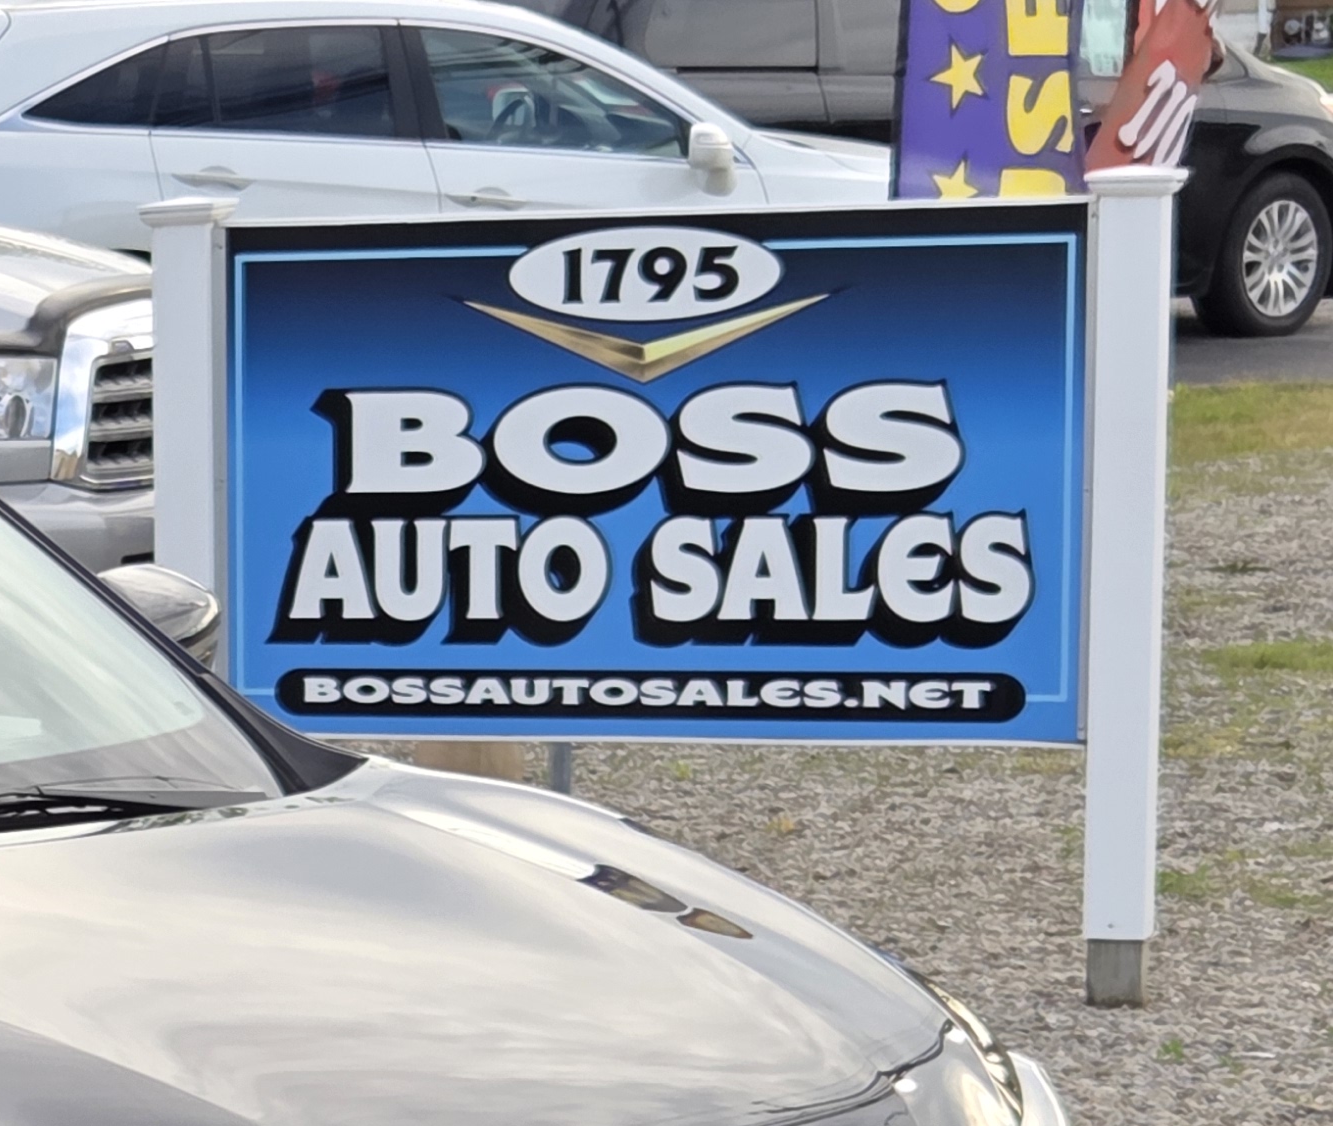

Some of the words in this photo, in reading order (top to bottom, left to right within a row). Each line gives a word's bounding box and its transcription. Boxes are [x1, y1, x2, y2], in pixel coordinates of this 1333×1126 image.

[559, 245, 740, 303] 1795
[335, 383, 963, 498] BOSS
[285, 516, 609, 624] AUTO
[647, 515, 1032, 625] SALES
[303, 676, 993, 710] BOSSAUTOSALES.NET
